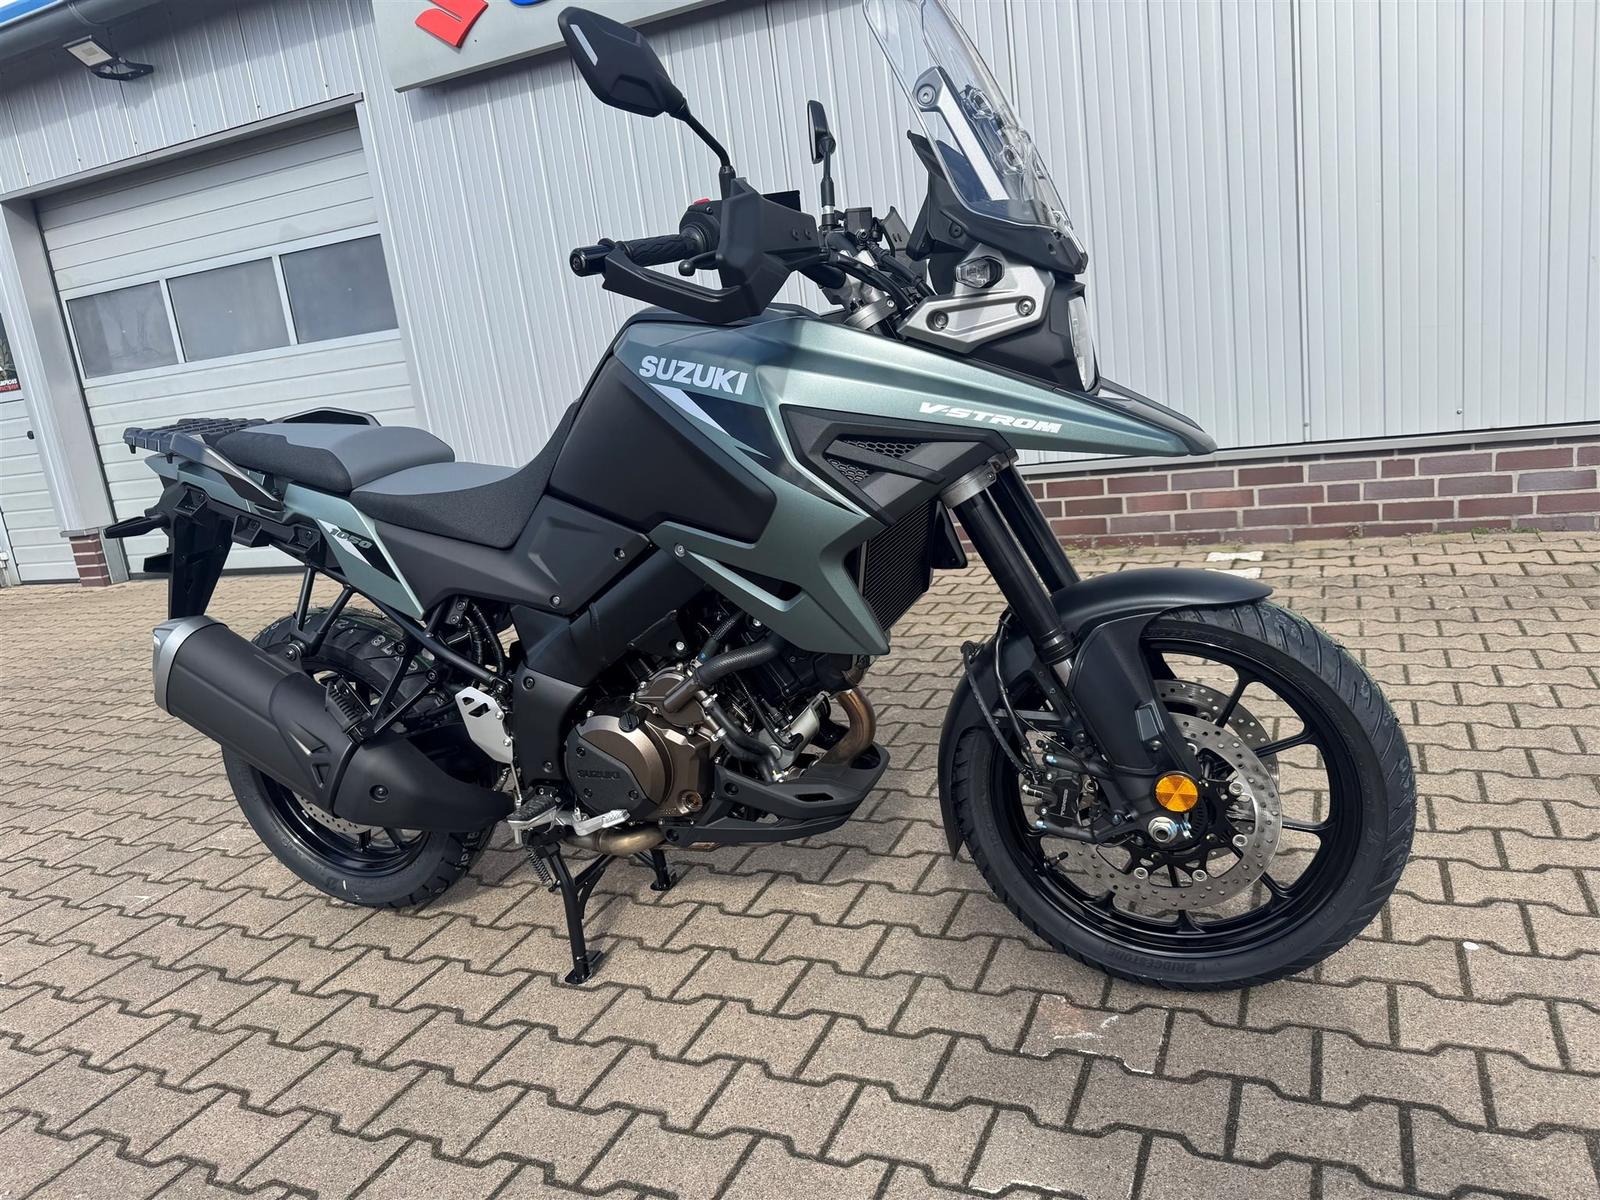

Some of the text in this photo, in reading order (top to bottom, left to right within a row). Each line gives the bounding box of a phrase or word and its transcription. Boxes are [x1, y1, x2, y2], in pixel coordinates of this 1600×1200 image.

[639, 355, 748, 395] SUZUKI
[919, 402, 1063, 434] V-STROM
[329, 528, 373, 549] 1050
[577, 769, 621, 780] SUZUKI
